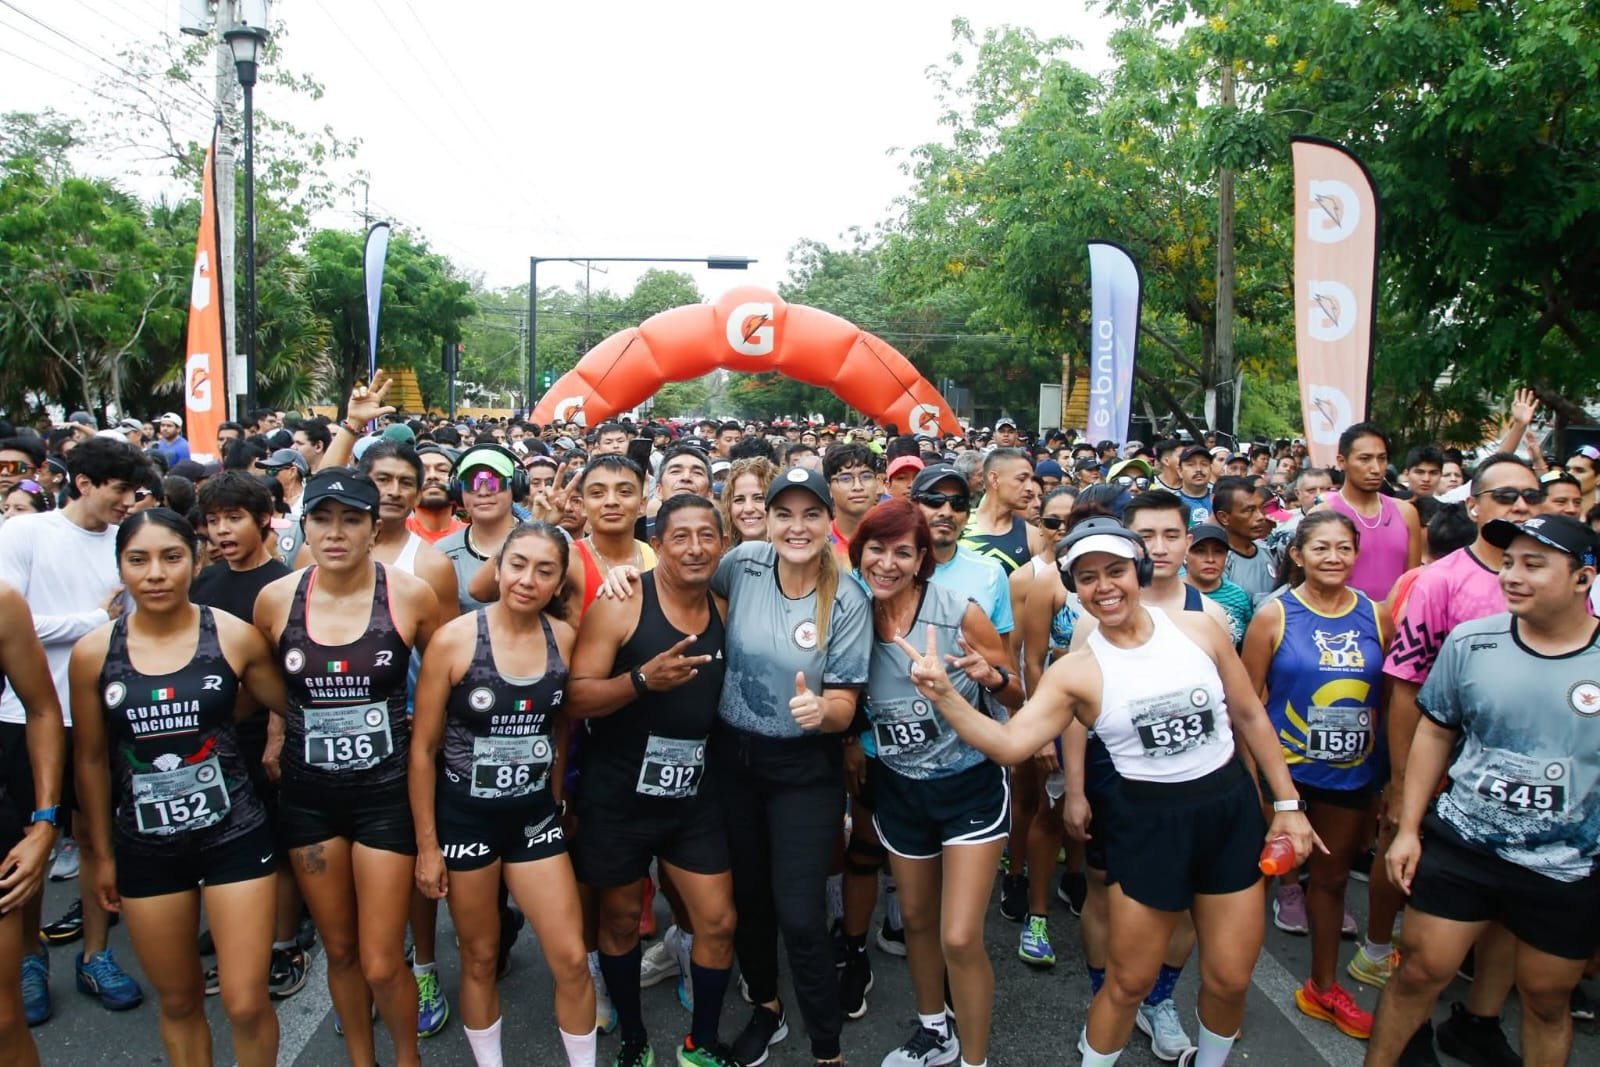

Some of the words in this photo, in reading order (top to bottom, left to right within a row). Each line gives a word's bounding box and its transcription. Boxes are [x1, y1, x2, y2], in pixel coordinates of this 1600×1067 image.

[726, 302, 775, 356] G
[185, 353, 212, 412] G
[908, 404, 940, 437] G
[1319, 650, 1365, 668] ADG
[305, 676, 371, 688] GUARDIA
[309, 687, 370, 698] NACIONAL
[126, 699, 200, 721] GUARDIA
[491, 713, 546, 725] GUARDIA
[131, 714, 200, 734] NACIONAL
[490, 724, 540, 735] NACIONAL
[886, 722, 926, 745] 135
[1151, 714, 1203, 746] 533
[324, 734, 373, 762] 136
[1317, 731, 1366, 752] 1581
[495, 764, 530, 789] 86
[659, 766, 695, 788] 912
[1489, 779, 1553, 809] 545
[154, 791, 211, 826] 152
[527, 825, 564, 849] PR
